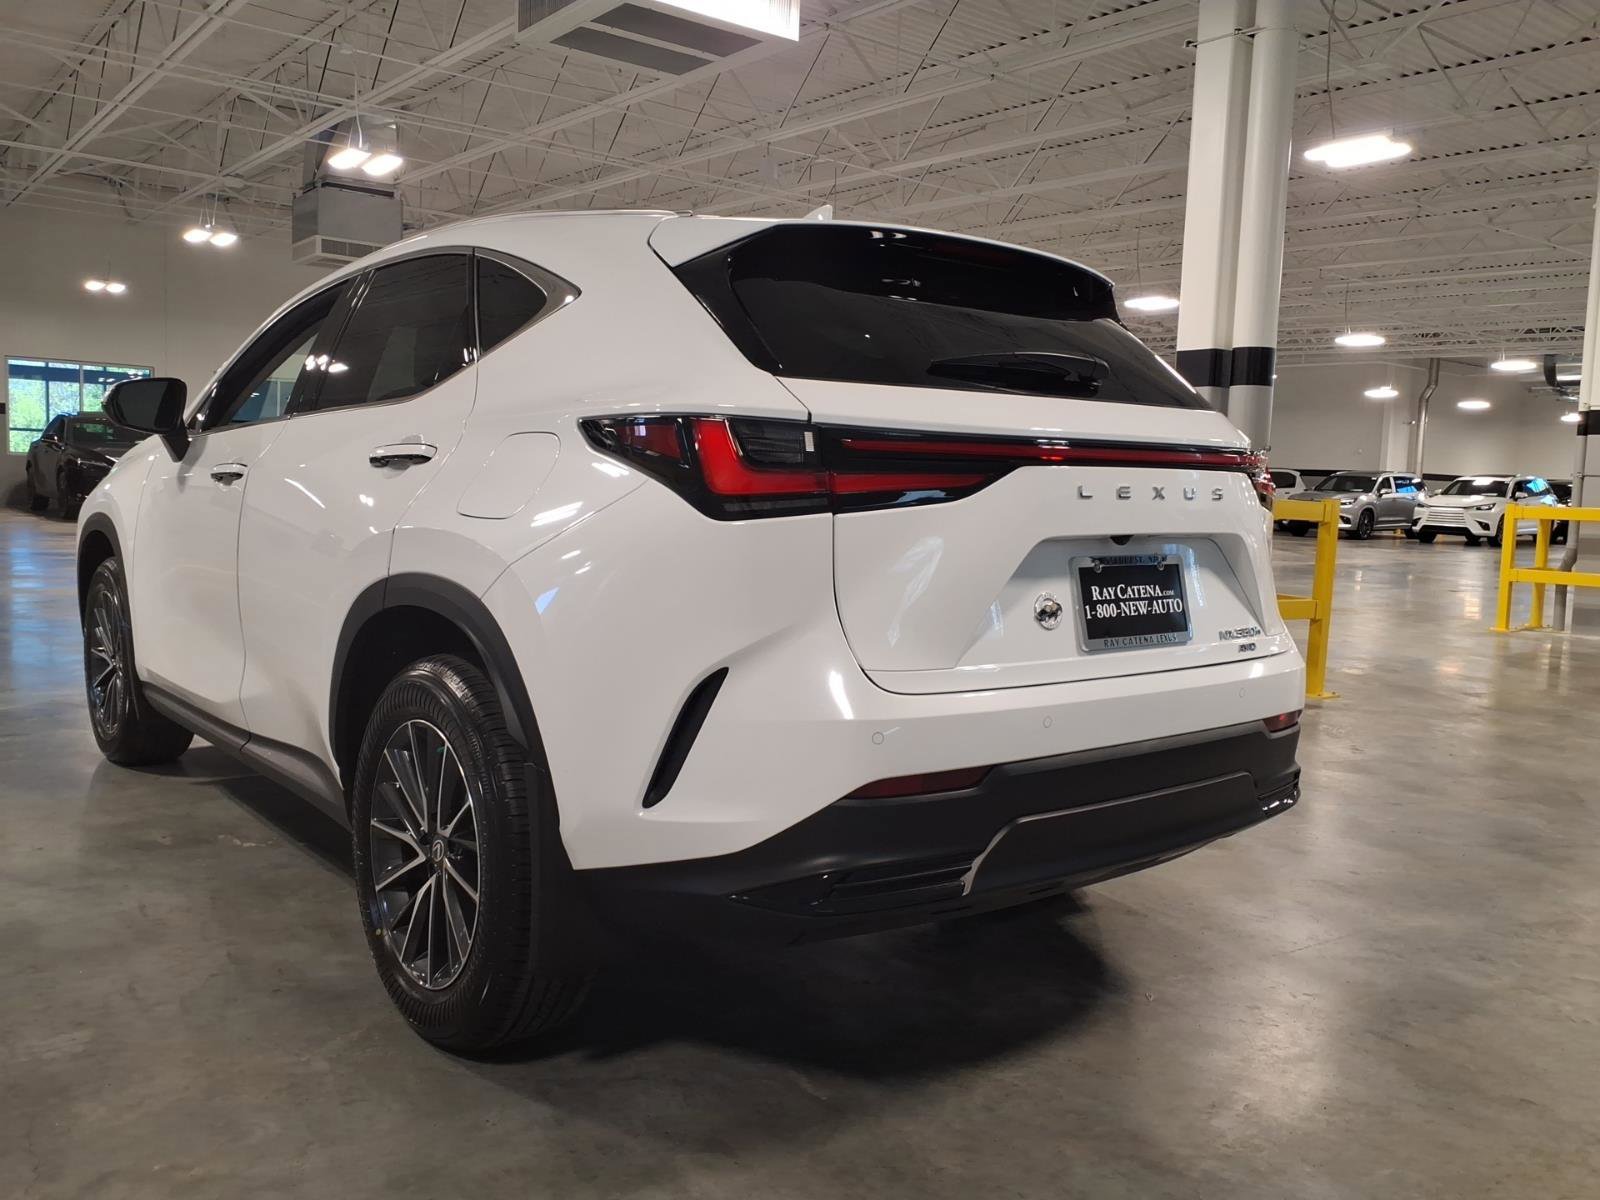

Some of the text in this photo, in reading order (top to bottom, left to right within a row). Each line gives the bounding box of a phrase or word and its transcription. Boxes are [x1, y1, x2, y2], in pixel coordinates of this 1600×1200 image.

[1077, 485, 1224, 501] LEXUS
[1085, 598, 1183, 619] 1-800-NEW-AUTO
[1103, 633, 1177, 648] RAY CATENA LEXUS
